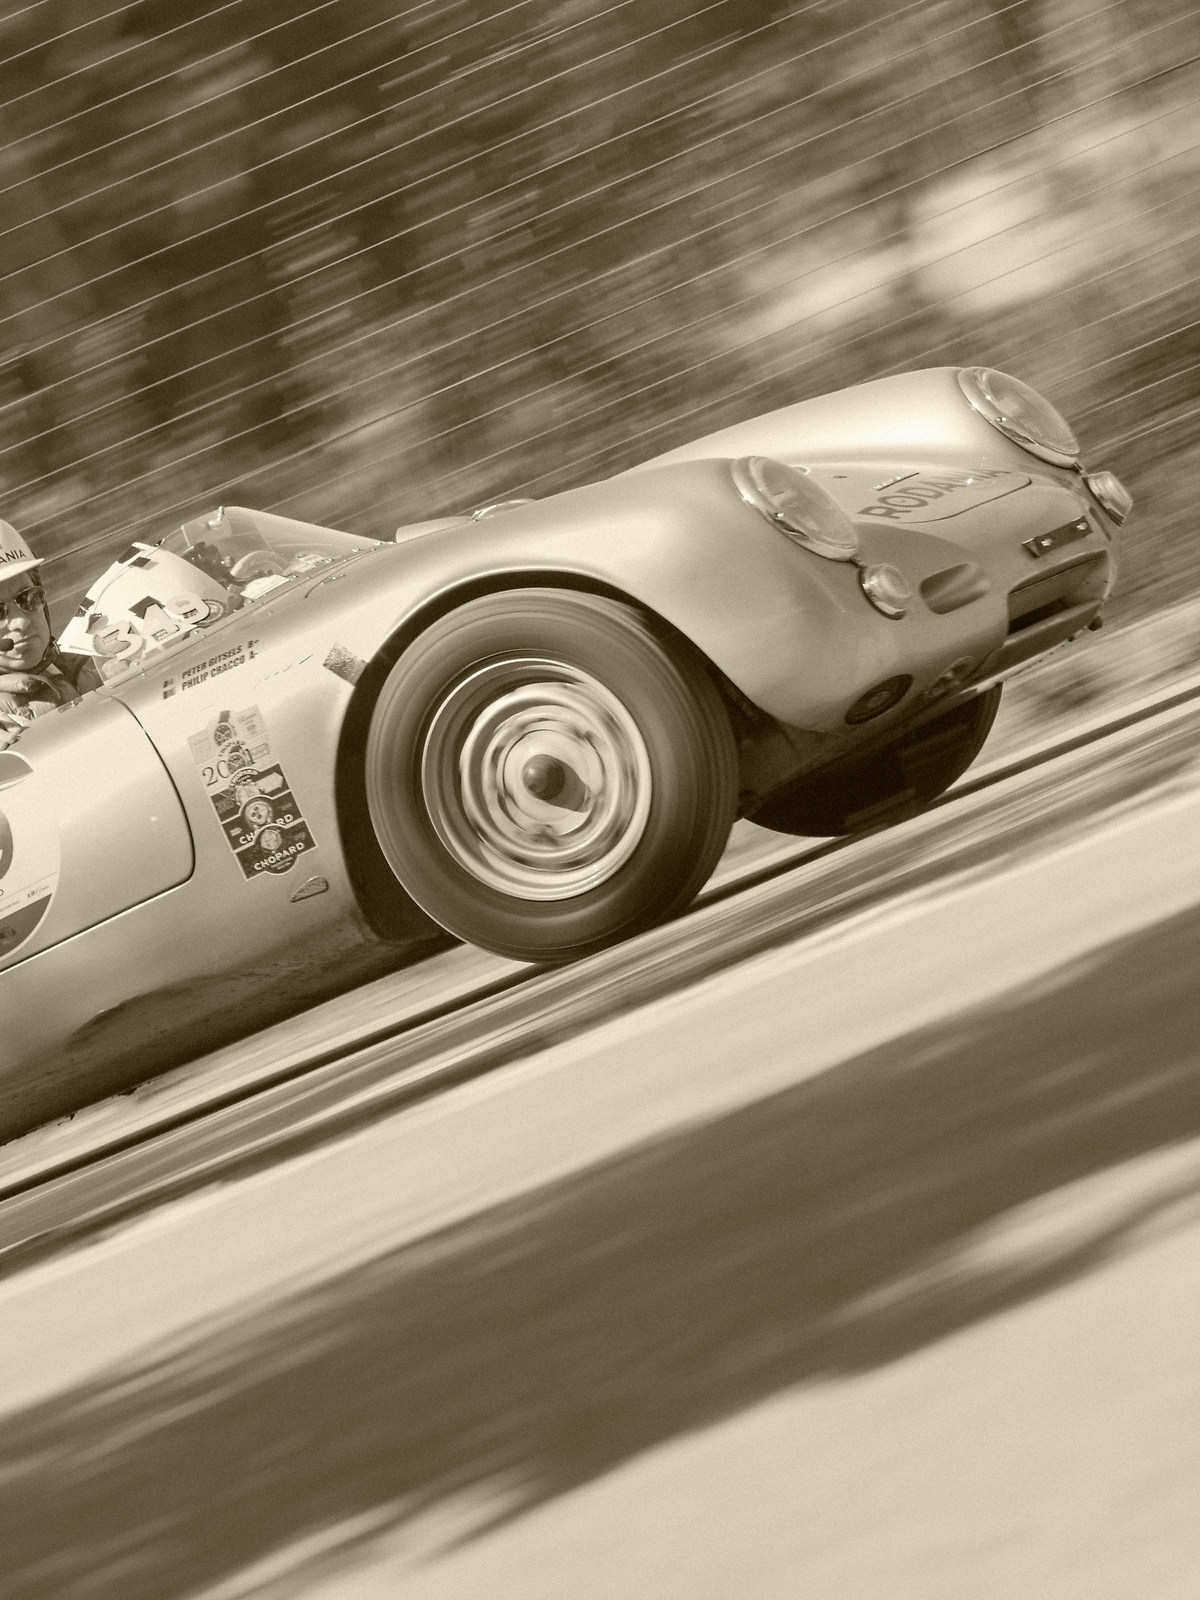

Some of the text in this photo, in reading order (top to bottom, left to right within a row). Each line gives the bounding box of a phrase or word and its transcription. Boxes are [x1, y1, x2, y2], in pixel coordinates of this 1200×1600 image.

[857, 468, 1011, 519] RODANIA
[182, 662, 207, 680] PETER
[208, 645, 242, 667] GITSELS
[182, 671, 209, 691] PHILIP
[210, 655, 245, 678] CRACCO
[239, 813, 294, 845] CHRD
[253, 842, 305, 871] CHOPARD
